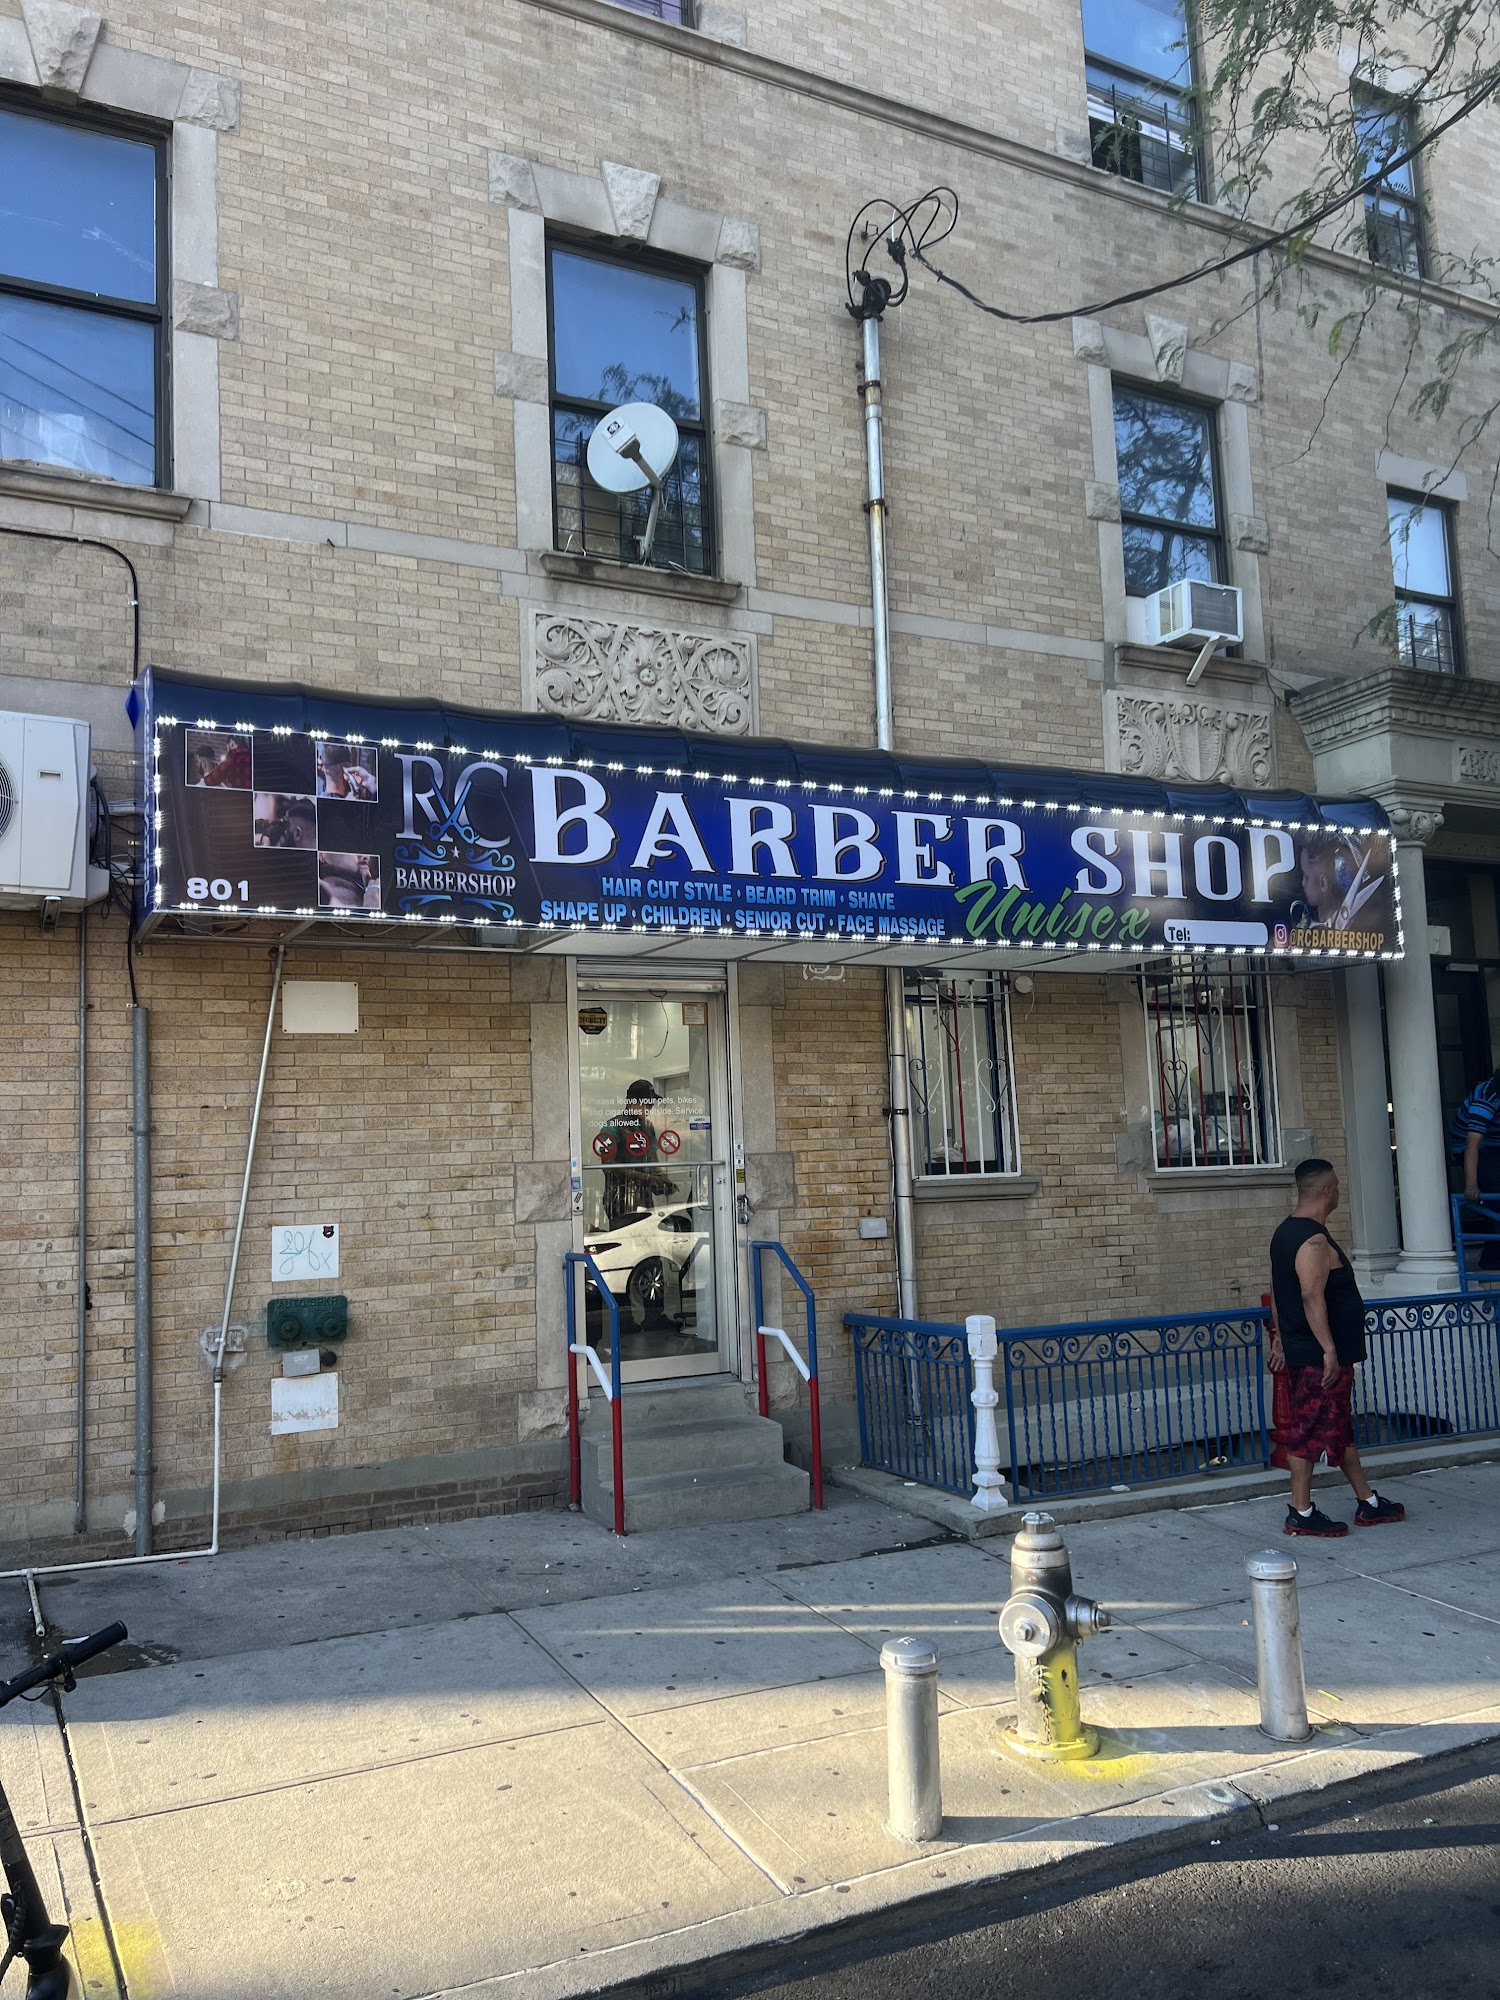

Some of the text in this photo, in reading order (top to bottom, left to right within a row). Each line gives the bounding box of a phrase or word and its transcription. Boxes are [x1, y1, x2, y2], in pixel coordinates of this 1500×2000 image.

[394, 753, 511, 848] RC
[524, 766, 1296, 903] BARBER SHOP
[187, 877, 249, 902] 801
[395, 867, 516, 897] BARBERSHOP
[602, 876, 896, 911] HAIR CUT STYLE BEARD TRIM SHAVE
[541, 900, 946, 936] SHAPE UP CHILDREN SENIOR CUT FACE MASSAGE
[953, 878, 1151, 941] Unisex
[1168, 926, 1191, 942] Tel:
[1290, 928, 1384, 950] @RCBARBERSHOP
[605, 1107, 643, 1117] cigarettes
[675, 1105, 703, 1115] Service
[617, 1097, 637, 1105] leave
[639, 1098, 656, 1107] your
[657, 1096, 675, 1105] pets,
[677, 1095, 697, 1104] bikes
[588, 1118, 641, 1128] dogs allowed.
